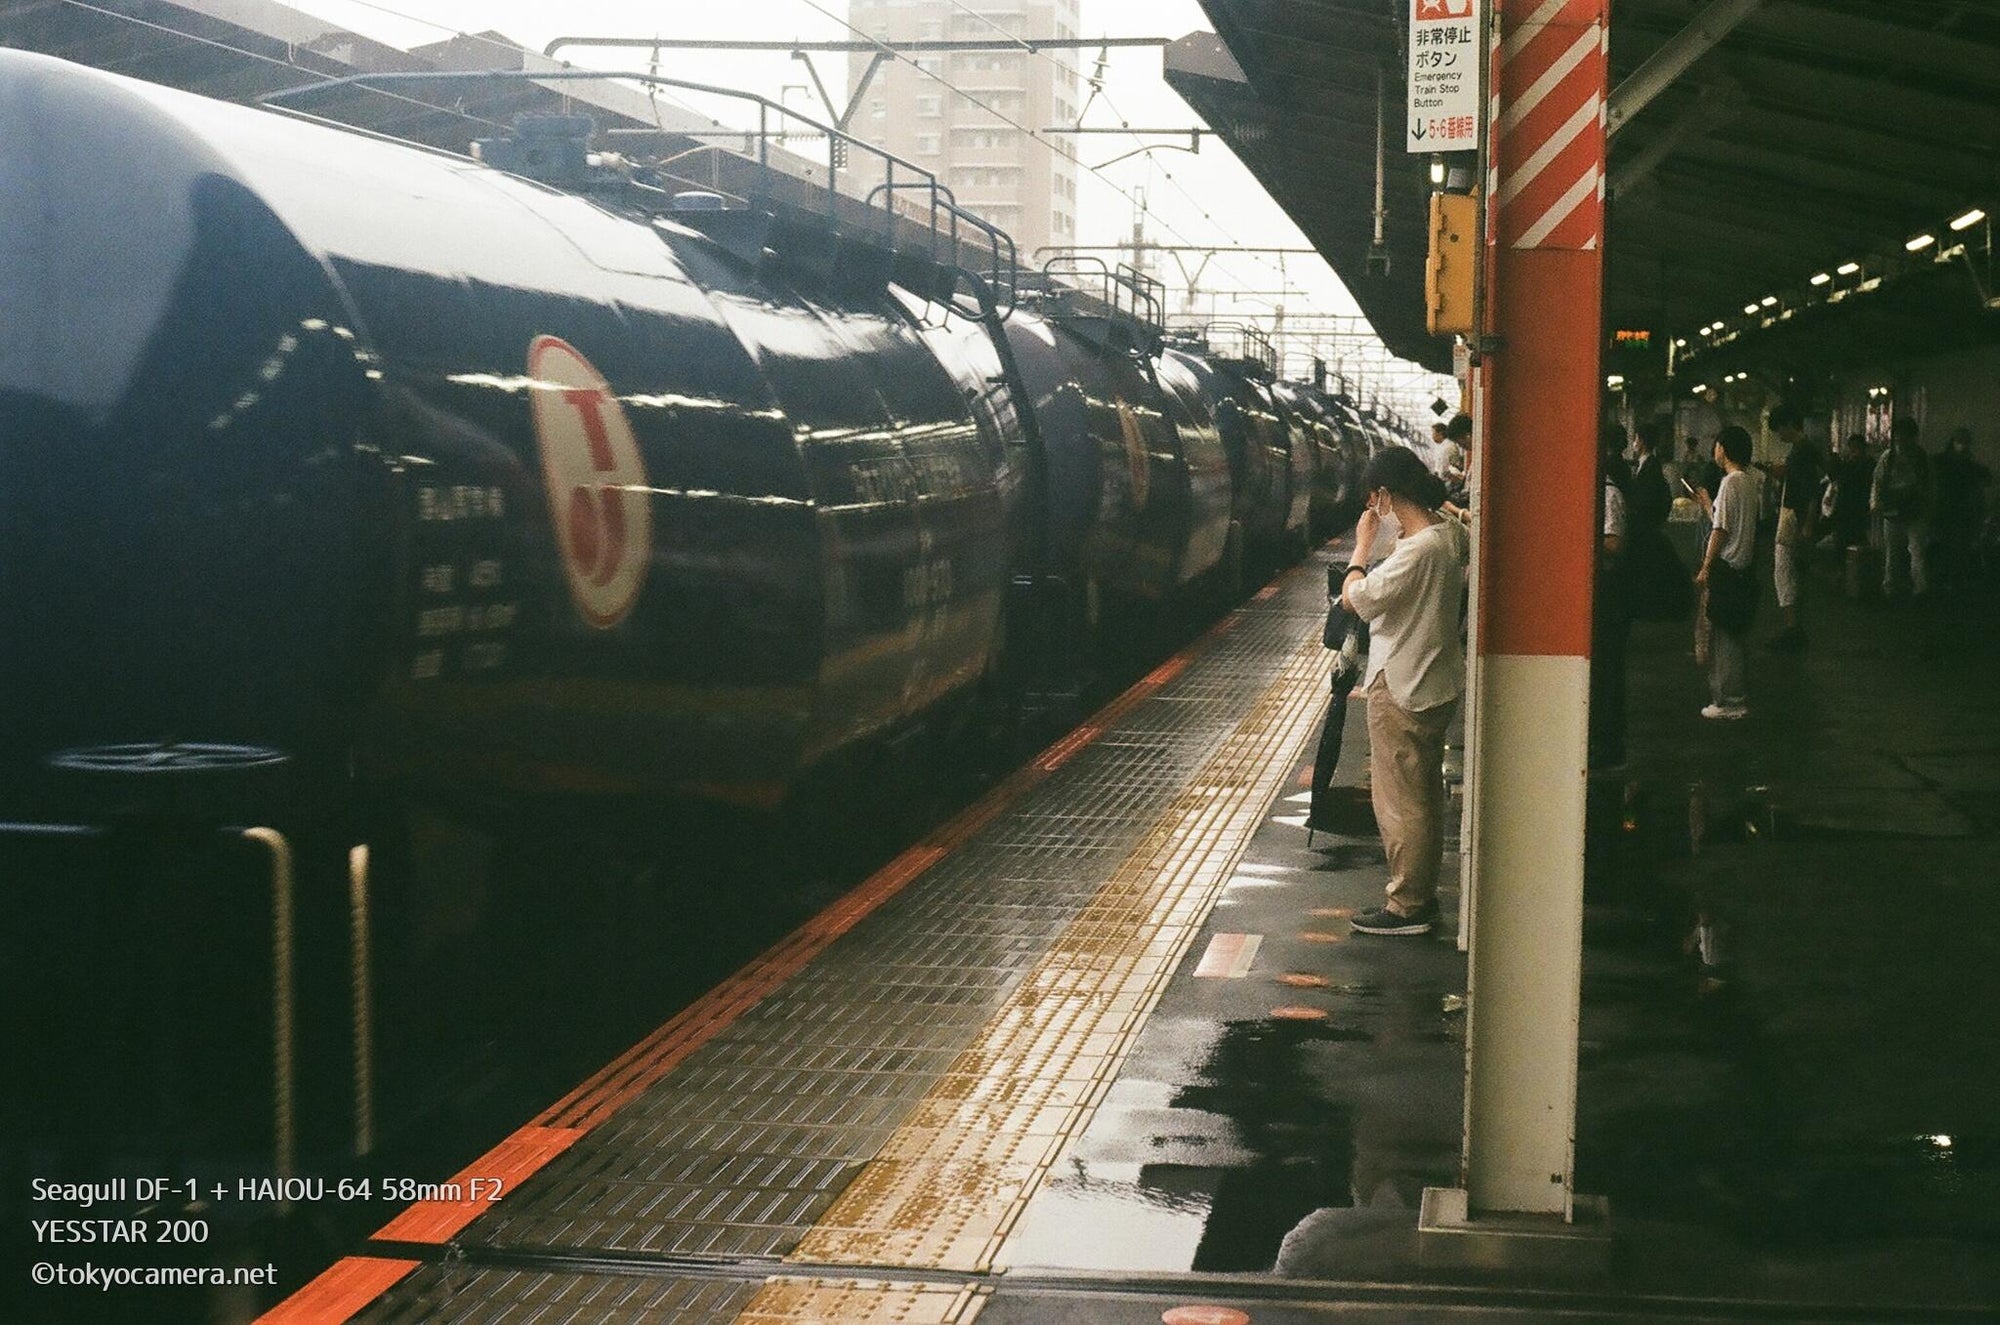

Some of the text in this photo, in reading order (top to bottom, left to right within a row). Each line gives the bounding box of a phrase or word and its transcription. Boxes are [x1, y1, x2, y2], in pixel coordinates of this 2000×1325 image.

[1416, 26, 1471, 46] 非常停止
[1416, 51, 1457, 68] ボタン
[1414, 71, 1463, 82] Emergency
[1414, 83, 1460, 95] Train Stop
[1414, 98, 1443, 108] Button
